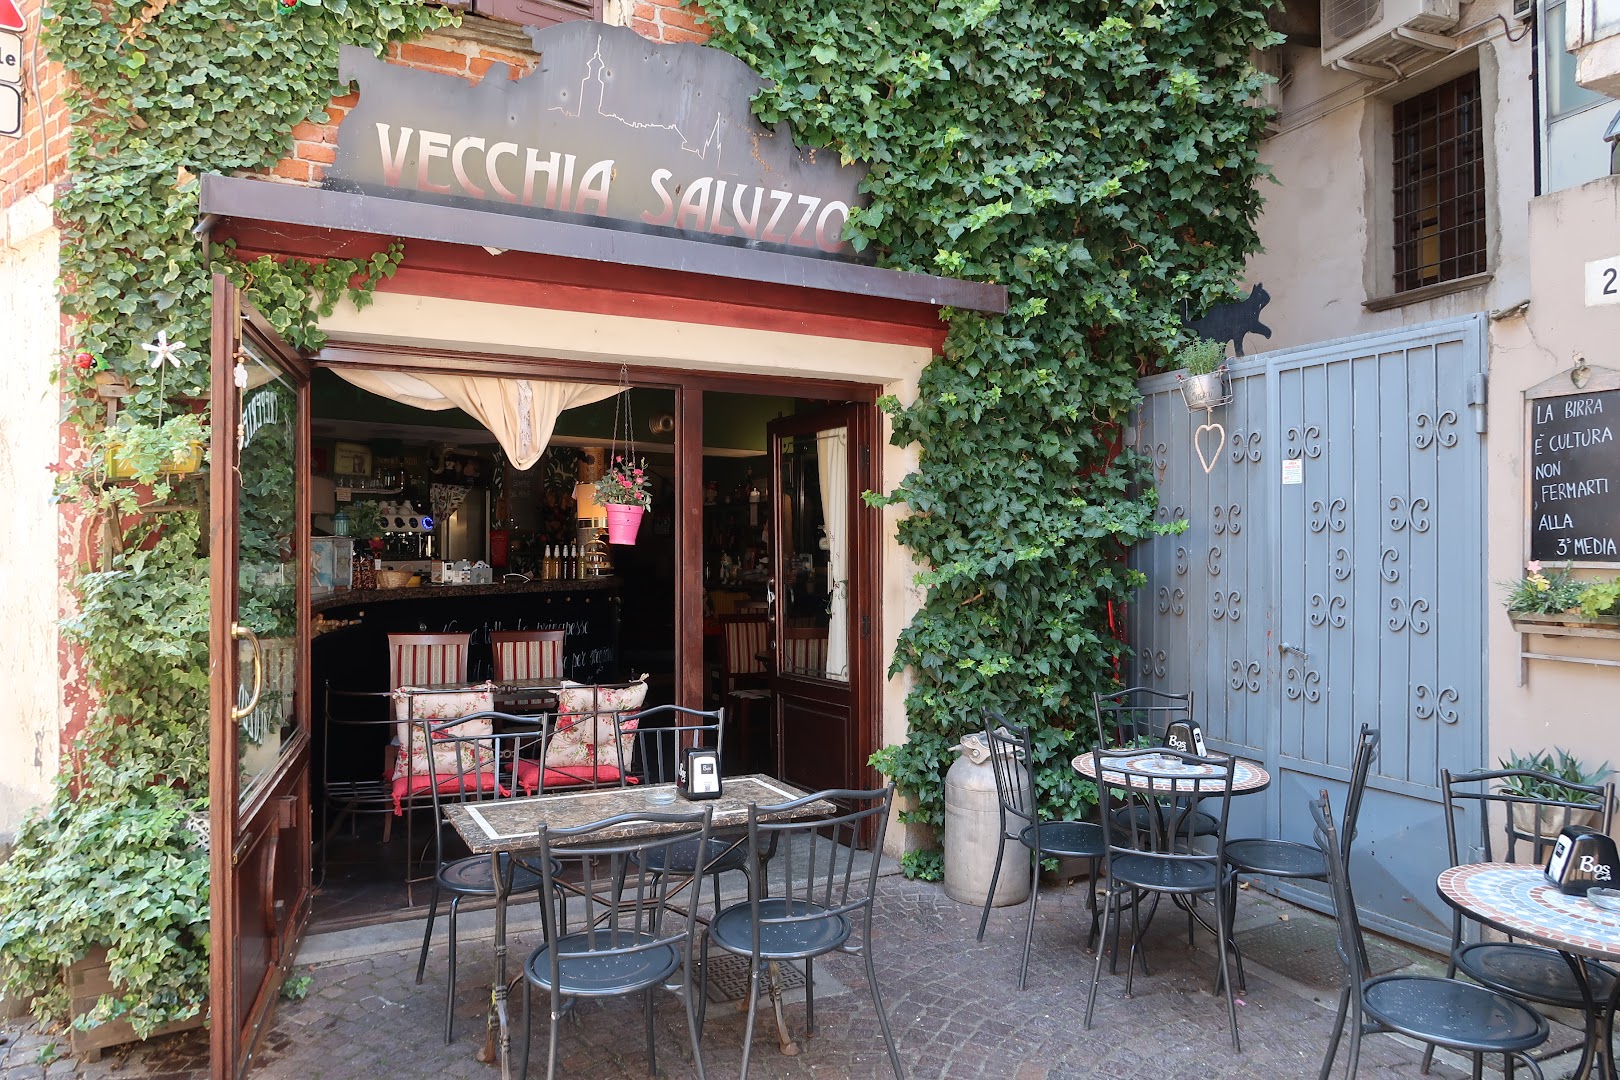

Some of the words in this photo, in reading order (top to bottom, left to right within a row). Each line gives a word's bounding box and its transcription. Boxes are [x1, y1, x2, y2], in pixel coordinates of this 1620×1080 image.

[376, 122, 615, 216] VECCHIA
[640, 168, 850, 253] SALUZZO
[1603, 268, 1618, 295] 2
[1537, 404, 1554, 425] LA
[1565, 398, 1603, 419] BIRRA
[1549, 427, 1613, 452] CULTURA
[1535, 461, 1561, 480] NON
[1541, 478, 1608, 503] FERMARTI
[1538, 513, 1574, 531] ALLA
[1574, 537, 1617, 555] MEDIA
[1168, 734, 1187, 747] Bos
[1580, 855, 1612, 874] Bos
